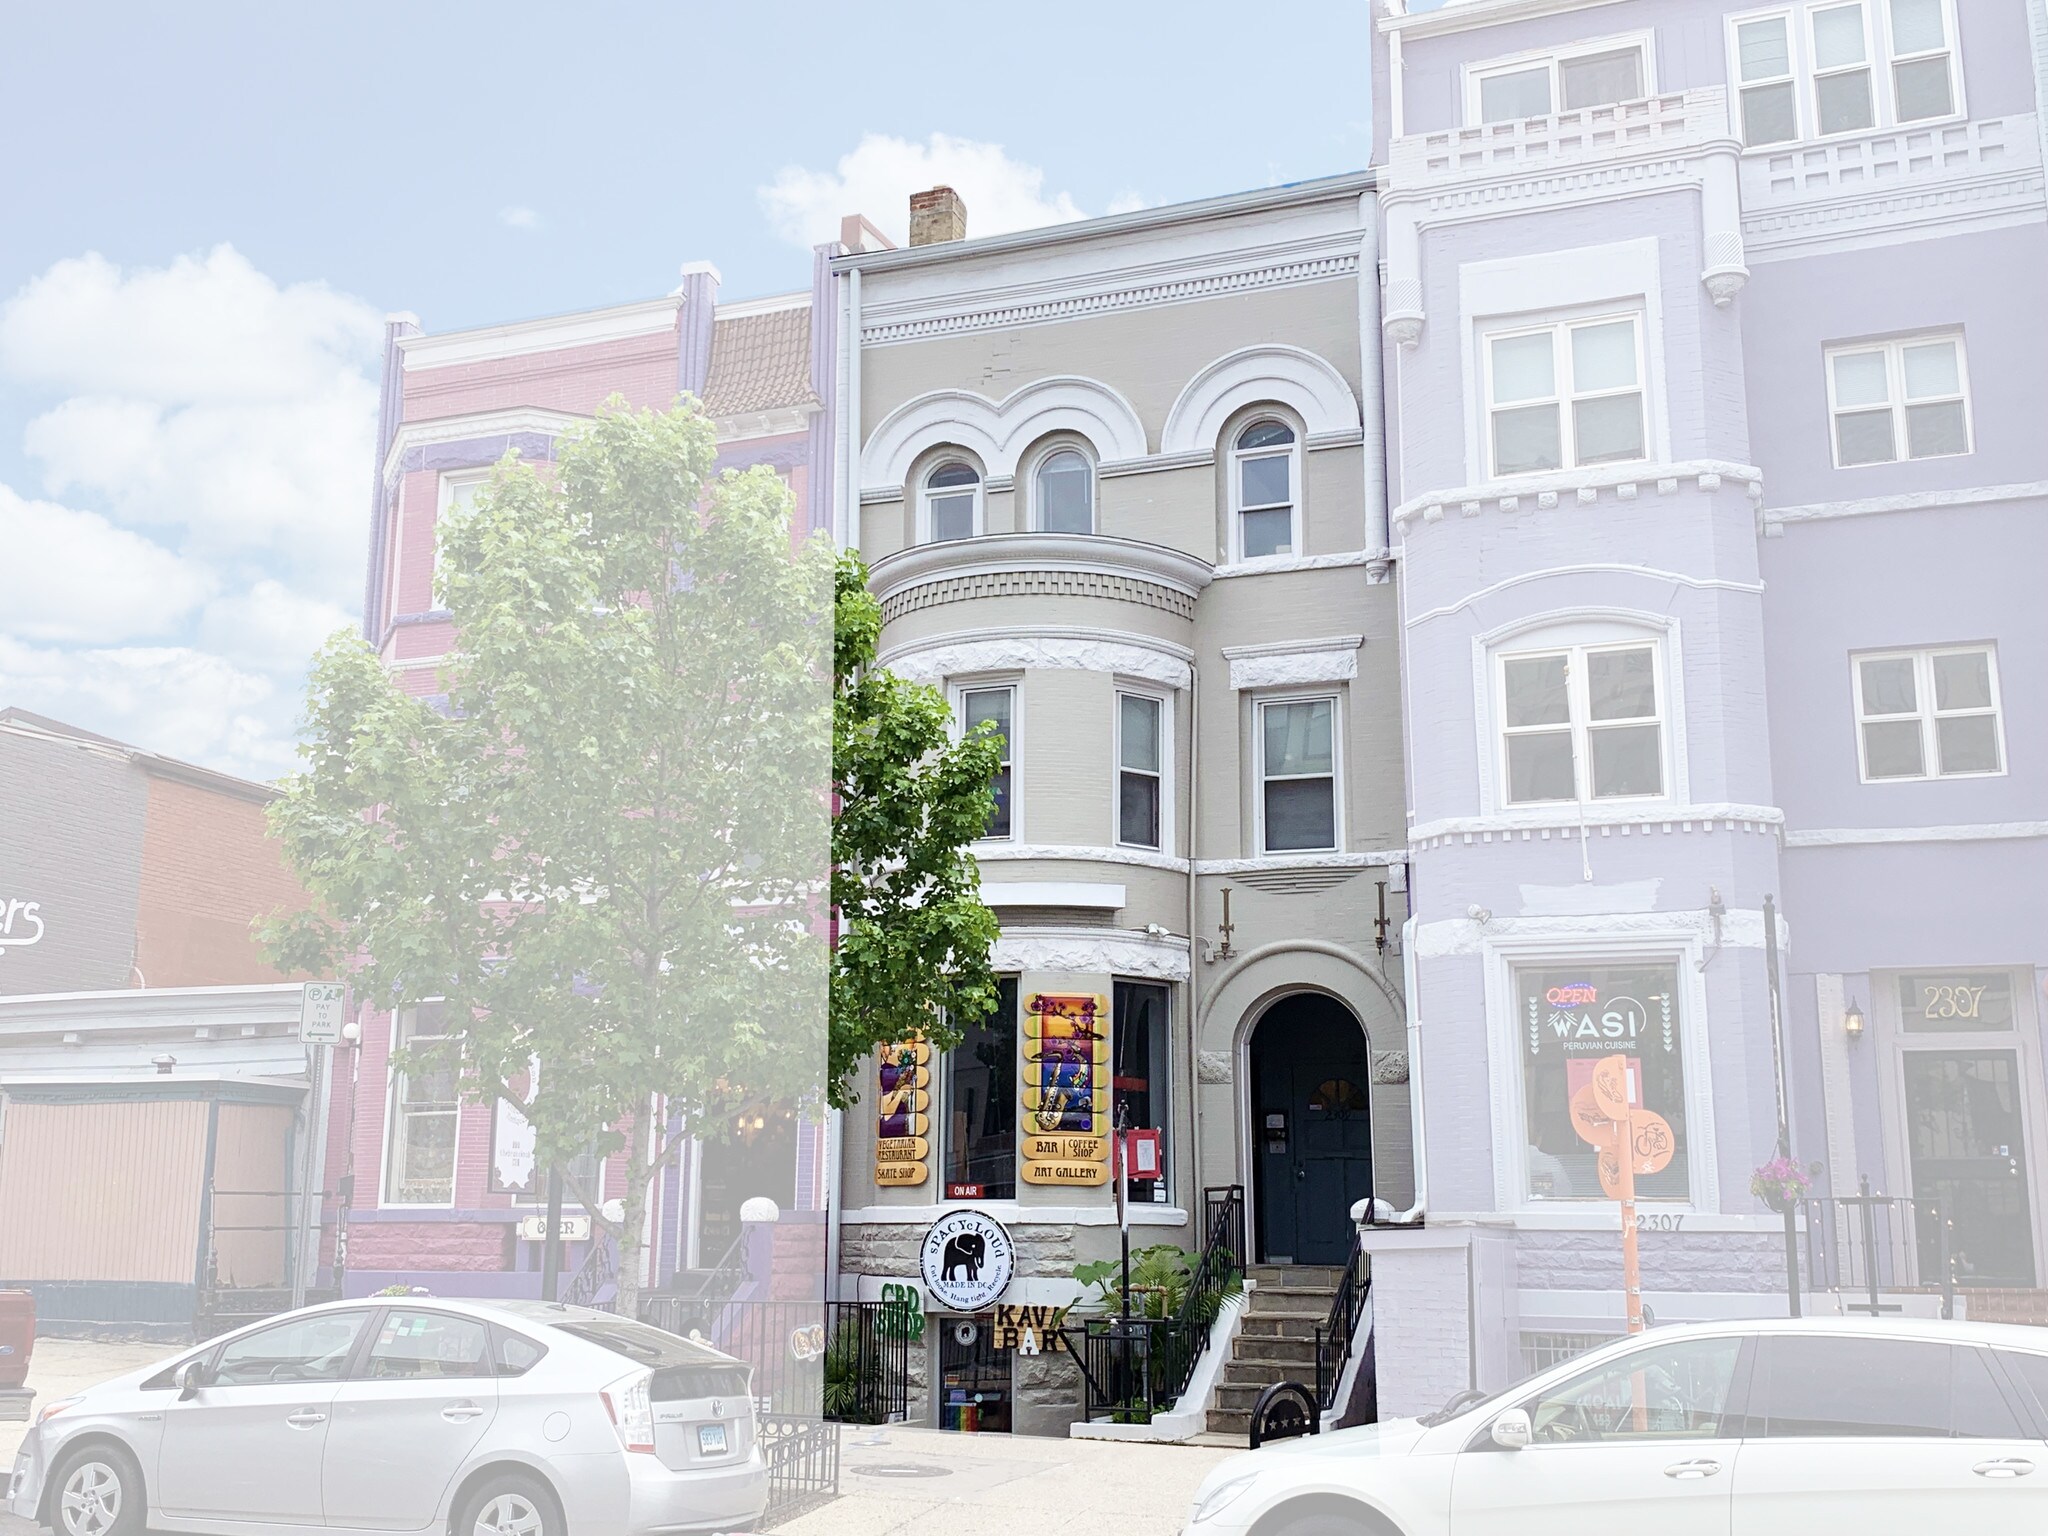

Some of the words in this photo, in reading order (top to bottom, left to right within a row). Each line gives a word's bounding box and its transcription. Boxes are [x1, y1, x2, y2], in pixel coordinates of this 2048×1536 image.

[1547, 987, 1598, 1003] OPEN
[1924, 985, 1987, 1018] 2307
[1548, 1011, 1637, 1038] WASI
[1563, 1041, 1603, 1050] PERUVIAN
[1604, 1041, 1637, 1050] CUISINE
[878, 1138, 916, 1150] VEGETARIAN
[1036, 1141, 1058, 1154] BAR
[1068, 1139, 1099, 1149] COFFEE
[878, 1149, 917, 1160] RESTAURANT
[1072, 1148, 1094, 1158] SHOP
[877, 1168, 897, 1179] SKATE
[898, 1167, 916, 1178] SHOP
[1034, 1166, 1053, 1177] ART
[1055, 1167, 1098, 1178] GALLERY
[954, 1185, 965, 1196] ON
[965, 1185, 977, 1196] AIR
[1636, 1214, 1684, 1232] 2307
[943, 1281, 966, 1289] MADE
[967, 1281, 975, 1289] IN
[882, 1283, 919, 1313] CBD
[950, 1293, 970, 1304] Hang
[997, 1303, 1065, 1328] KAVA
[1002, 1327, 1059, 1356] BAR
